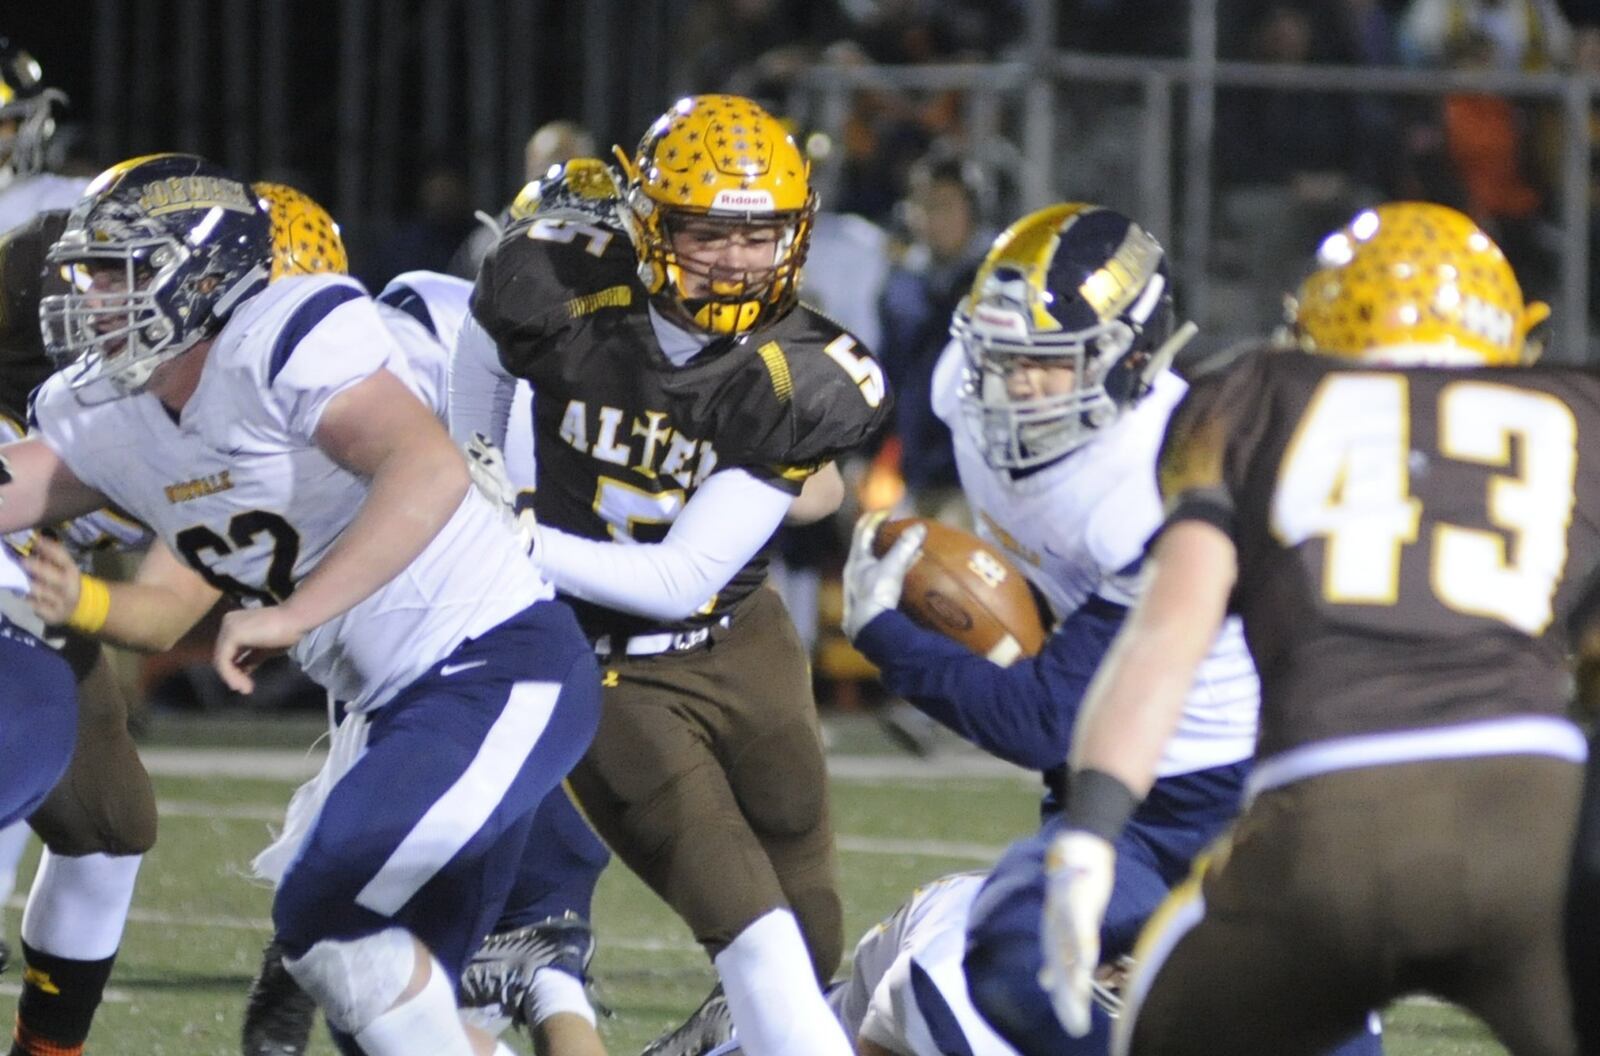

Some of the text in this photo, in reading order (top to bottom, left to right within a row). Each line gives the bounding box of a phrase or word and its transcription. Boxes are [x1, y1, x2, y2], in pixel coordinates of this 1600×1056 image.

[721, 195, 767, 204] Riddell
[823, 332, 885, 408] 5
[1268, 371, 1578, 638] 43
